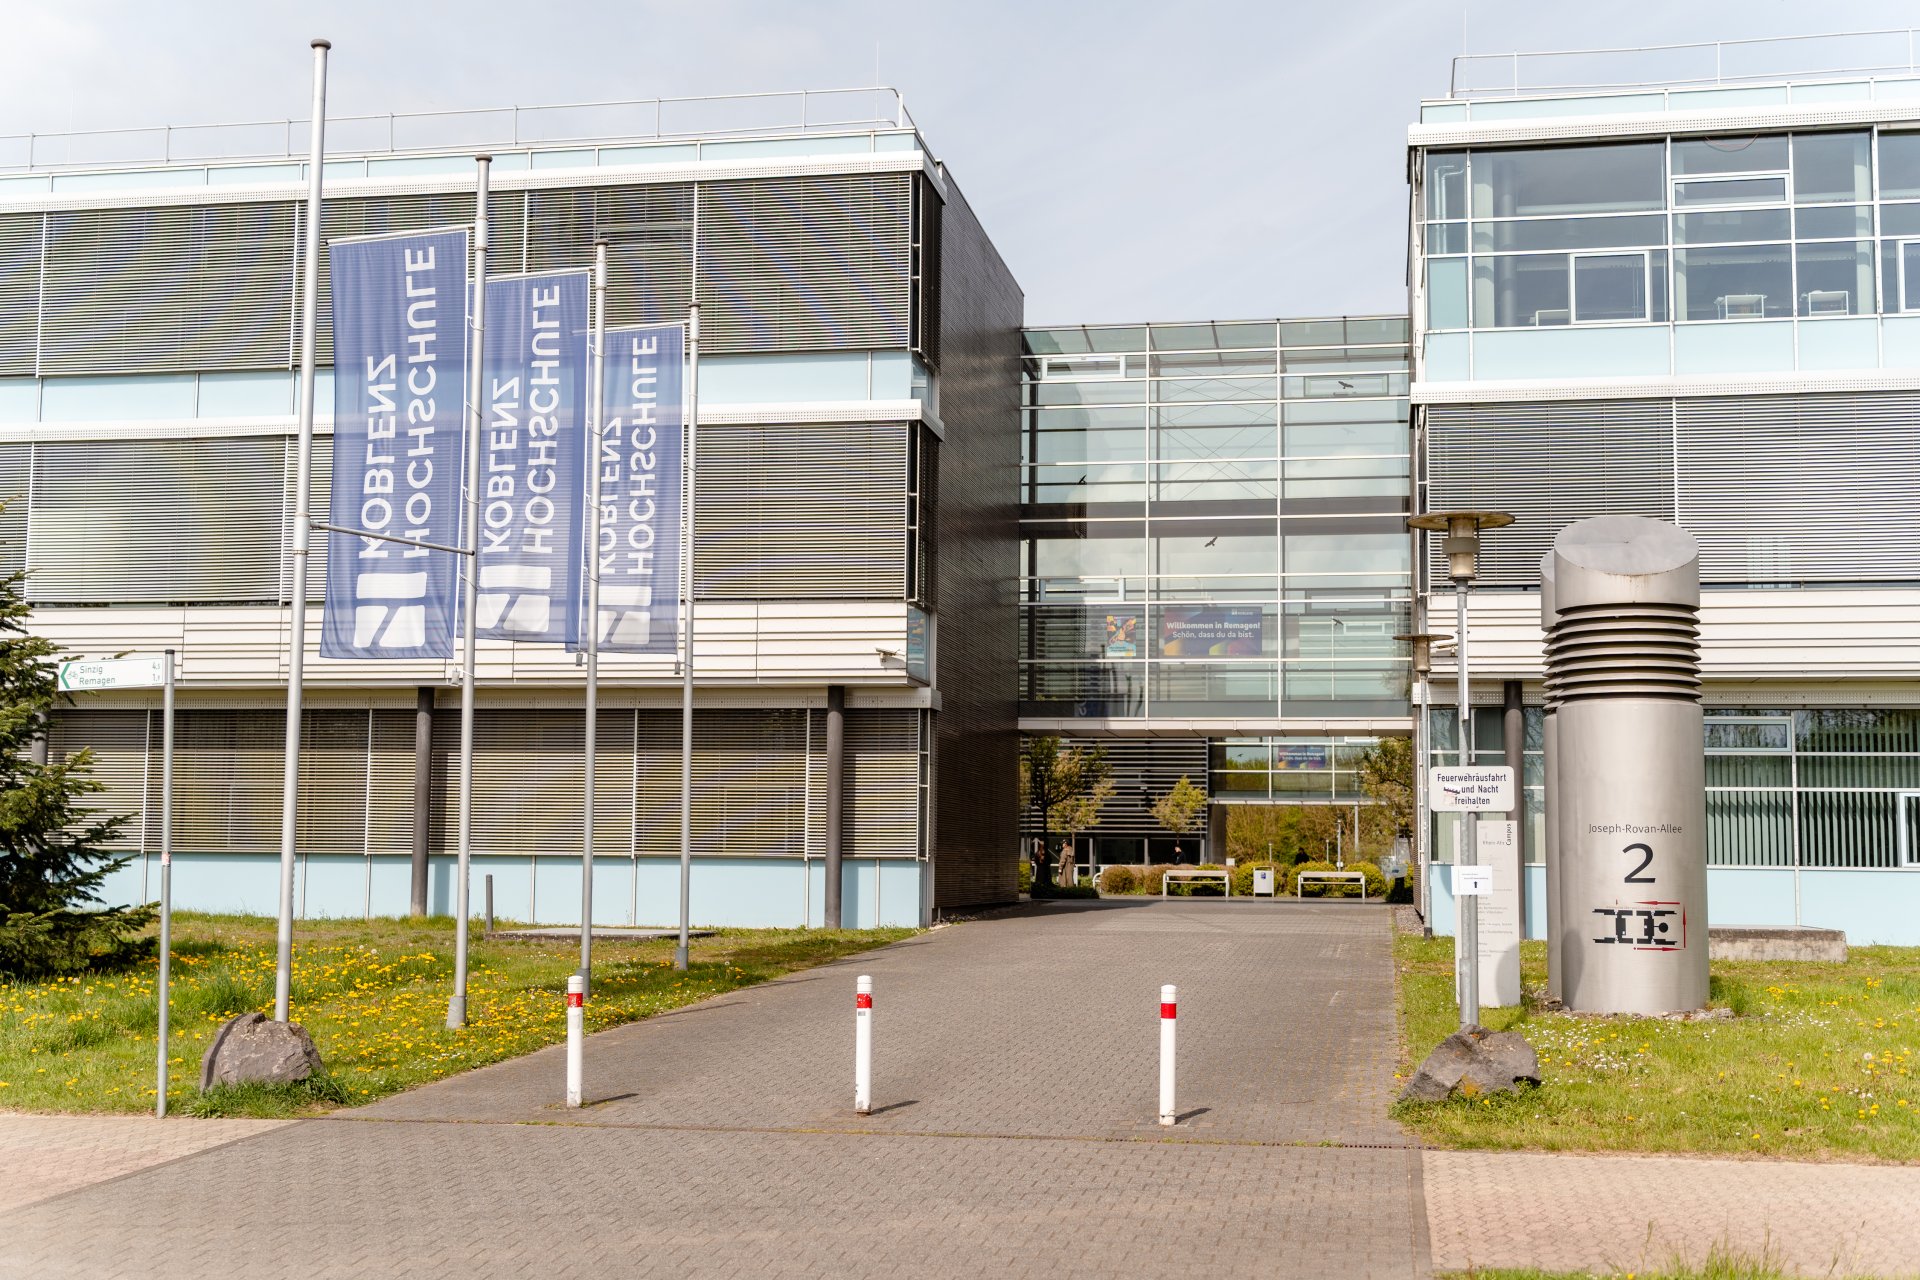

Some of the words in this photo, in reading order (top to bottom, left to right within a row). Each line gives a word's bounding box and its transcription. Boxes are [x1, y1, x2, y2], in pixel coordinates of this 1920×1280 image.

[1166, 621, 1214, 630] Willkommen
[1215, 621, 1222, 629] in
[1223, 621, 1261, 631] Remagen!
[1172, 631, 1196, 639] Schön,
[79, 665, 103, 675] Sinzig
[79, 677, 116, 687] Remagen
[1437, 773, 1507, 782] Feuerwehrausfahrt
[1461, 785, 1475, 793] und
[1478, 785, 1499, 793] Nacht
[1454, 796, 1491, 805] freihalten
[1588, 823, 1683, 835] Joseph-Rovan-Allee
[1622, 843, 1656, 883] 2
